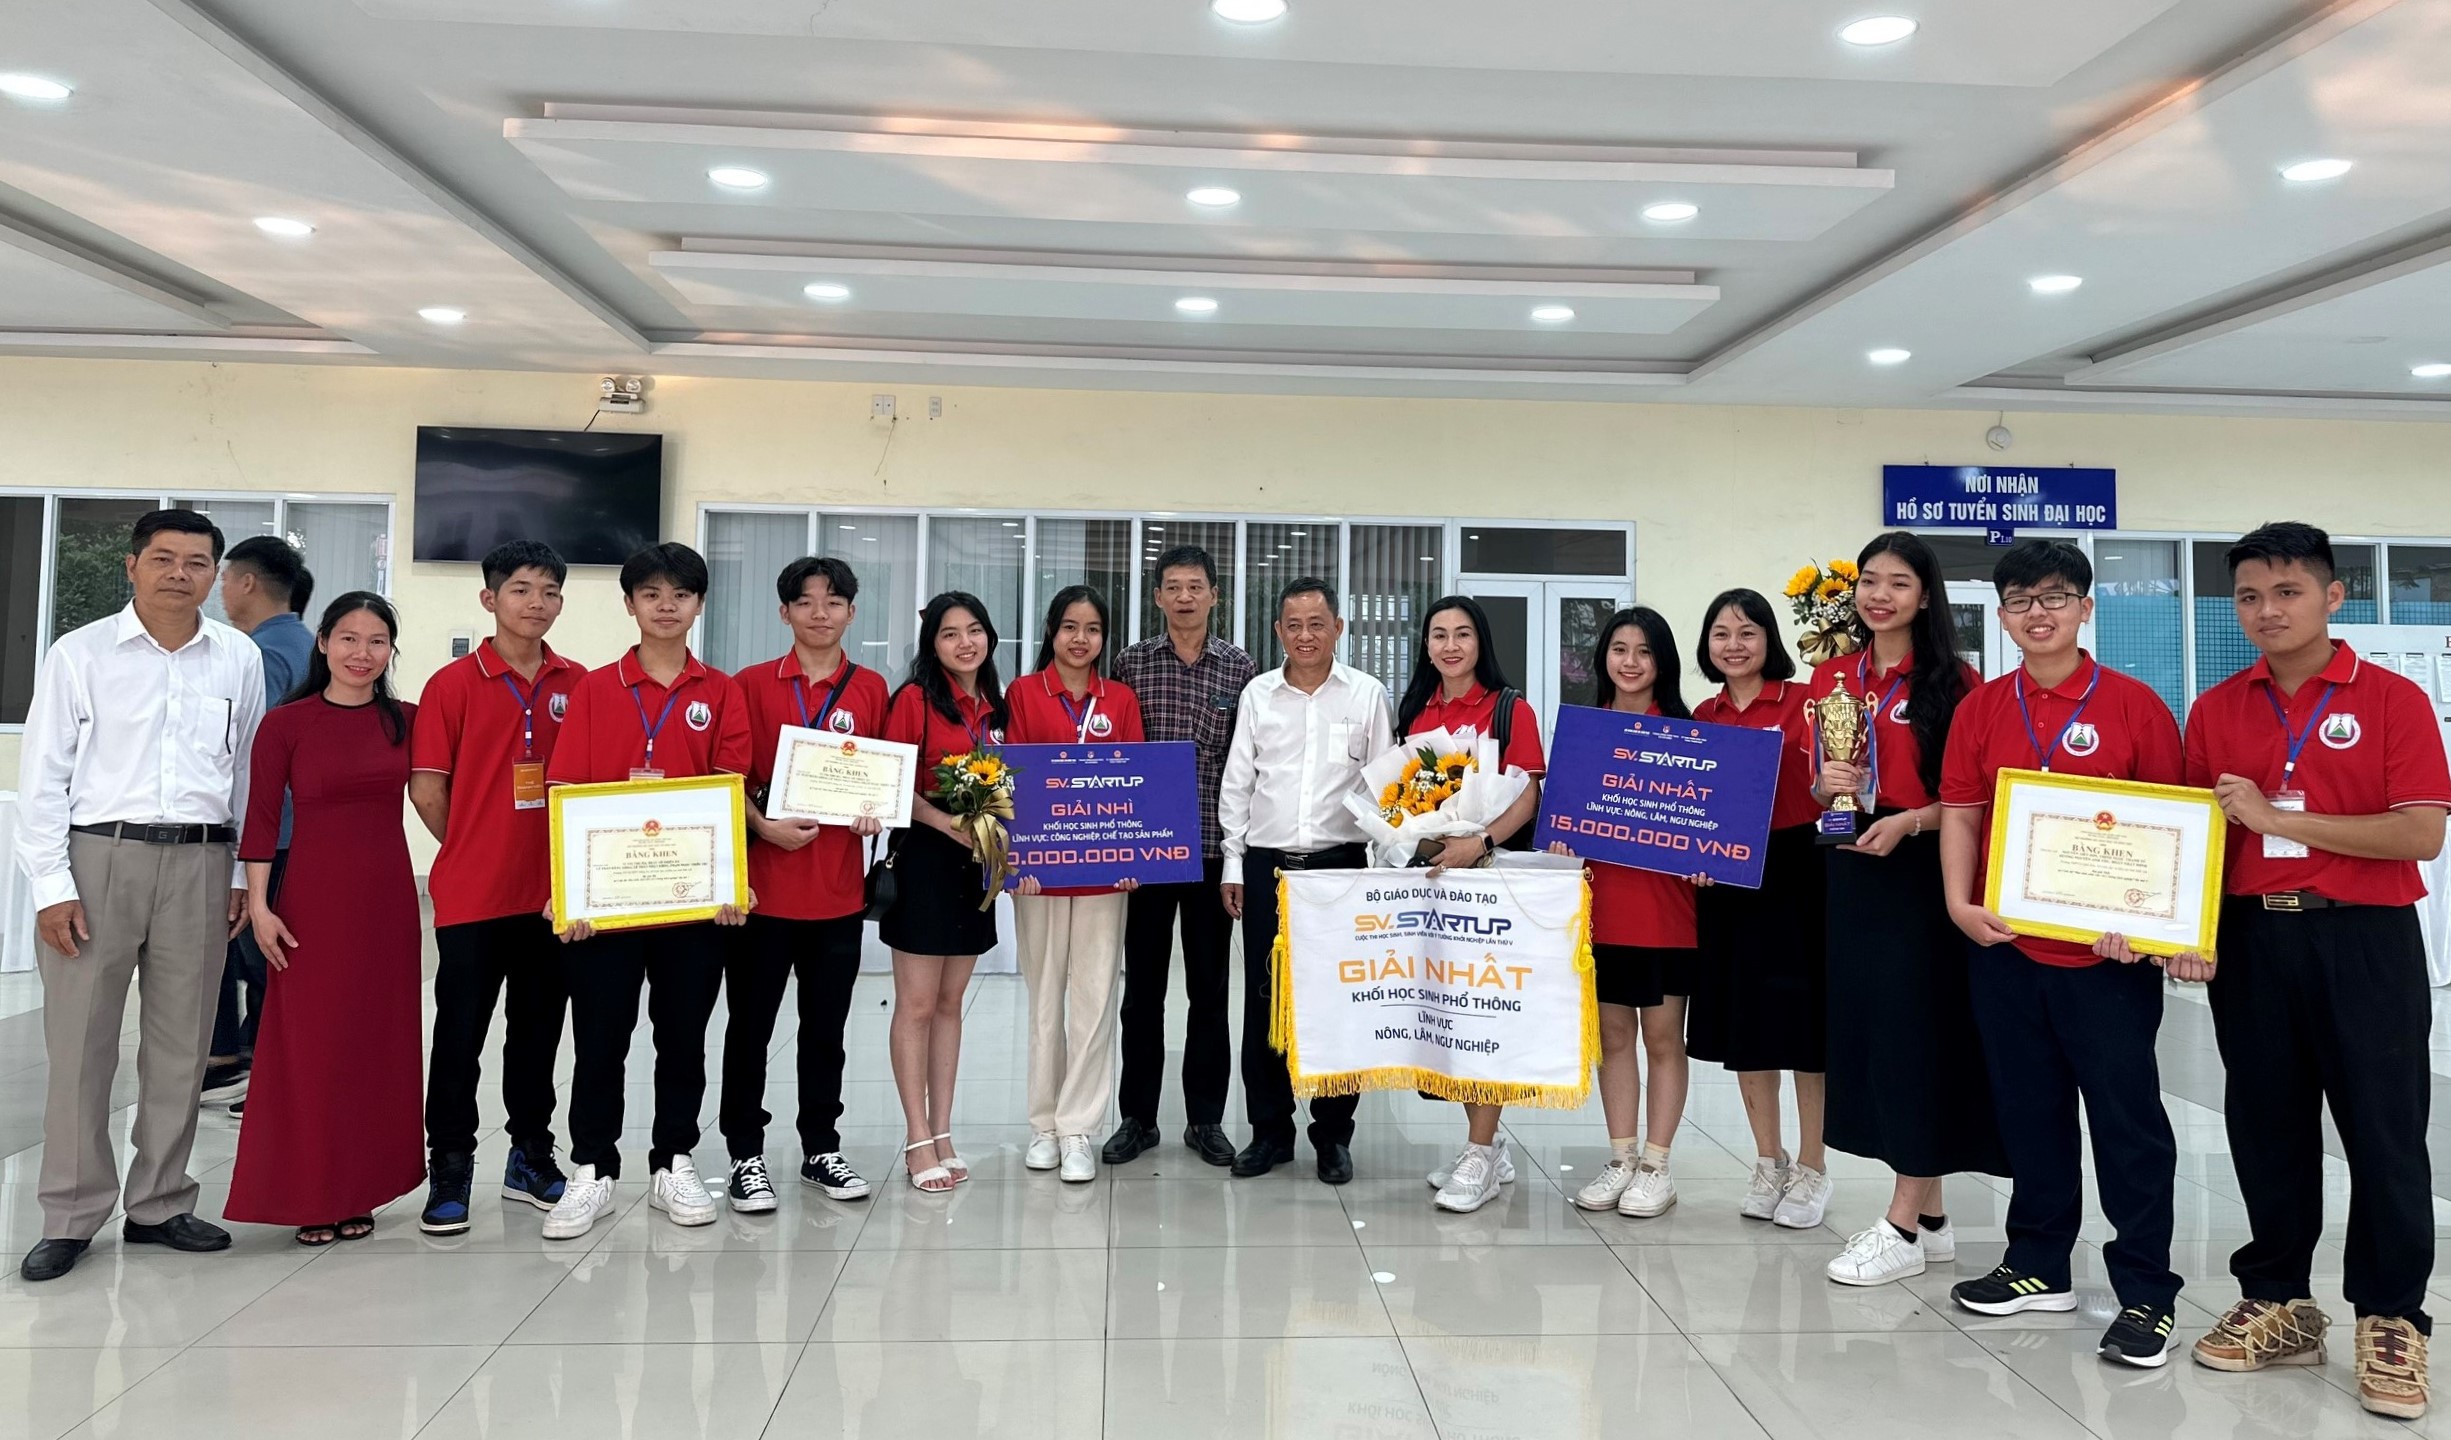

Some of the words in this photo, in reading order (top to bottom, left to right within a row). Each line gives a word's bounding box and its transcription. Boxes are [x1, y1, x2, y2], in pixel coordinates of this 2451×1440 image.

[1965, 475, 1991, 493] NƠI
[1997, 473, 2039, 496] NHẬN
[1897, 497, 1916, 519] HỒ
[1923, 501, 1944, 520] SƠ
[1949, 497, 1997, 521] TUYỂN
[2002, 503, 2038, 521] SINH
[2044, 505, 2069, 525] ĐẠI
[2076, 506, 2106, 525] HỌC
[1613, 748, 1717, 771] SV.STARTUP
[1046, 775, 1143, 788] SV.STARTUP
[1602, 773, 1642, 792] GIẢI
[1649, 780, 1712, 801] NHẤT
[1051, 800, 1090, 816] GIẢI
[1097, 798, 1133, 814] NHÌ
[1587, 802, 1603, 812] LĨNH
[1624, 807, 1648, 821] NÔNG,
[1670, 816, 1687, 826] NGƯ
[1689, 818, 1718, 831] NGHIỆP
[1602, 793, 1621, 803] KHỐI
[1622, 797, 1638, 807] HỌC
[1640, 799, 1658, 809] SINH
[1660, 801, 1676, 812] PHỔ
[1678, 805, 1705, 817] THÔNG
[1012, 834, 1030, 842] LĨNH
[1051, 833, 1071, 841] CÔNG
[1103, 830, 1117, 840] CHẾ
[1119, 831, 1133, 840] TẠO
[1135, 830, 1150, 839] SẢN
[1152, 827, 1173, 838] PHẨM
[1043, 820, 1061, 830] KHỐI
[1063, 823, 1078, 831] HỌC
[1080, 822, 1097, 830] SINH
[1100, 819, 1115, 829] PHỔ
[1117, 820, 1142, 828] THÔNG
[1550, 814, 1689, 850] 15.000.000
[1696, 838, 1751, 861] VNĐ
[1008, 848, 1134, 865] 0.000.000
[1140, 846, 1189, 860] VNĐ
[2072, 842, 2100, 854] BẰNG
[2104, 848, 2133, 858] KHEN
[1366, 889, 1380, 903] BỘ
[1384, 888, 1408, 901] GIÁO
[1412, 888, 1431, 899] DỤC
[1434, 889, 1447, 900] VÀ
[1450, 890, 1472, 903] ĐÀO
[1476, 893, 1497, 906] TẠO
[1355, 908, 1512, 935] SV.STARTUP
[1339, 950, 1414, 984] GIẢI
[1425, 952, 1533, 990] NHẤT
[1352, 986, 1384, 1003] KHỐI
[1388, 988, 1415, 1002] HỌC
[1418, 989, 1440, 1004] SINH
[1443, 991, 1469, 1008] PHỔ
[1472, 995, 1521, 1012] THÔNG
[1418, 1011, 1436, 1025] LĨNH
[1437, 1017, 1454, 1031] VỰC
[1375, 1027, 1411, 1041] NÔNG,
[1414, 1029, 1434, 1044] LÂM,
[1435, 1033, 1454, 1048] NGƯ
[1455, 1038, 1499, 1055] NGHIỆP
